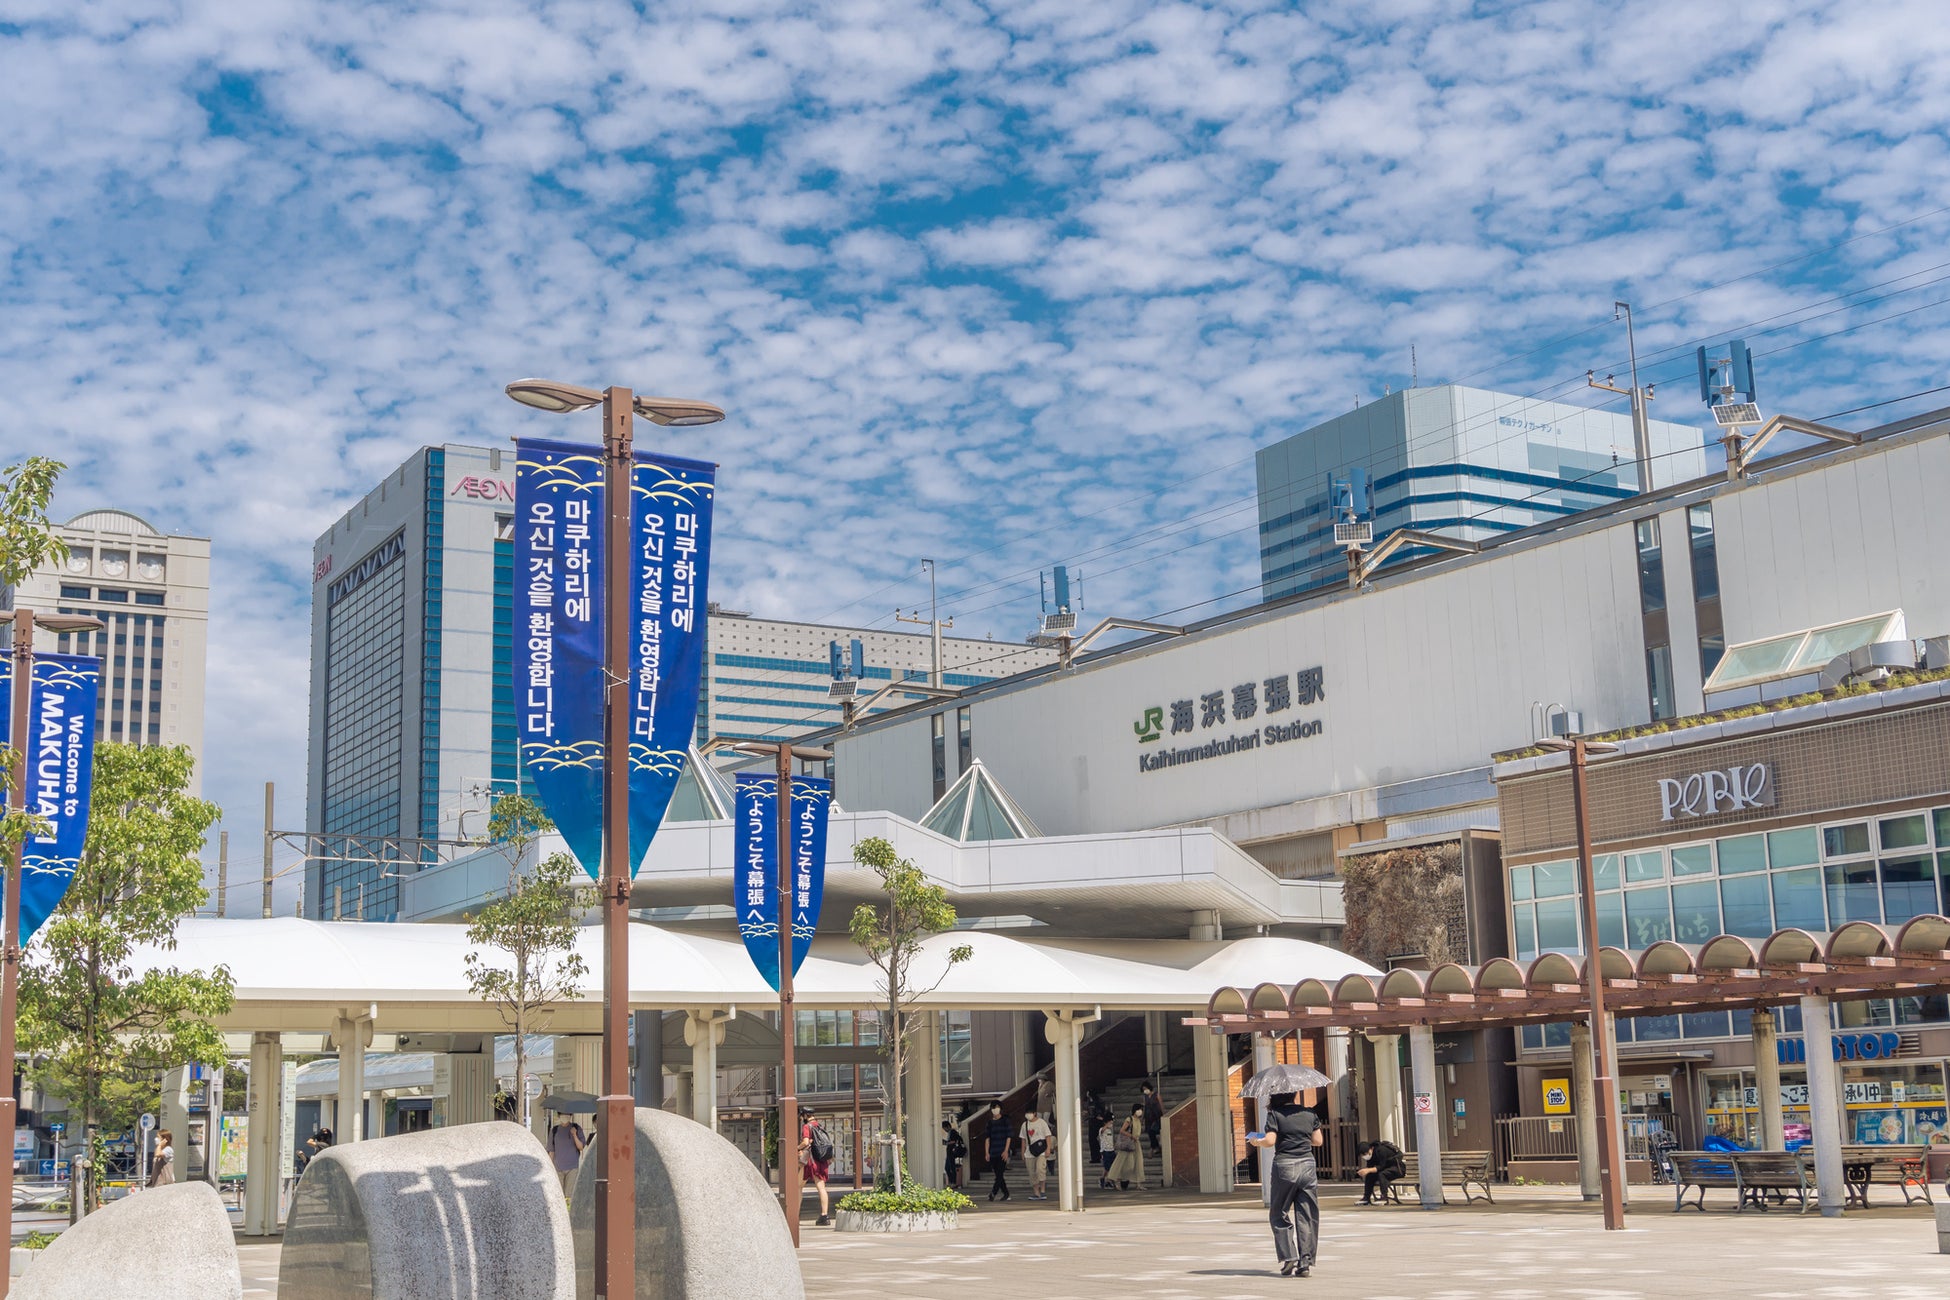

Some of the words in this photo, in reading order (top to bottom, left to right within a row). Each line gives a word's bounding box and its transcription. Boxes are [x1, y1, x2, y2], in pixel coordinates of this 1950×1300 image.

[528, 502, 555, 551] 오신
[564, 499, 591, 622] 마쿠하리에
[641, 513, 666, 562] 오신
[527, 557, 554, 607] 것을
[639, 565, 663, 615] 것을
[671, 512, 698, 633] 마쿠하리에
[527, 612, 555, 738] 환영합니다
[635, 618, 662, 741] 환영합니다
[1134, 706, 1164, 736] JR
[1170, 665, 1326, 736] 海浜幕張駅
[65, 714, 85, 794] Welcome
[1139, 729, 1261, 773] Kaihimmakuhari
[1264, 718, 1323, 745] Station
[64, 799, 79, 817] to
[747, 800, 765, 922] ようこそ幕張へ
[797, 804, 816, 925] ようこそ幕張へ
